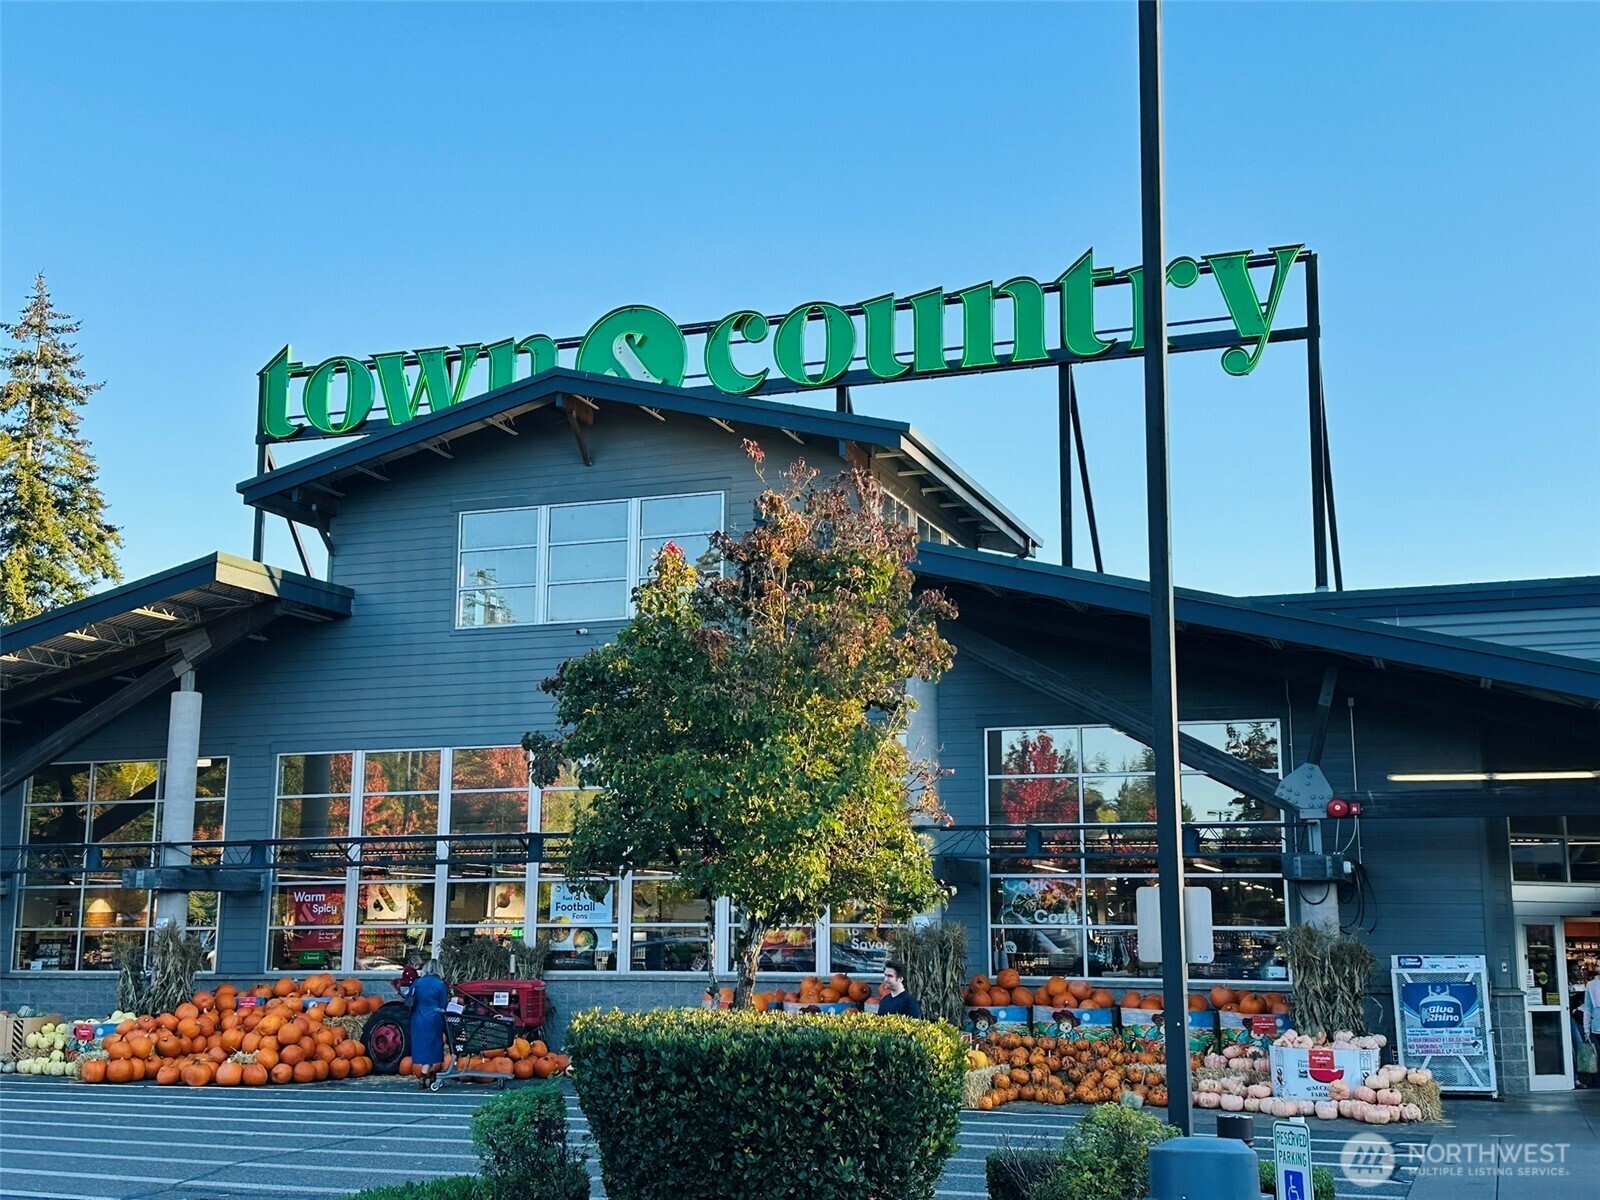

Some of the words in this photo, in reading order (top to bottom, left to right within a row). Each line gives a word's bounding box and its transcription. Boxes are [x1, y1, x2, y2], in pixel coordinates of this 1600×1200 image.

[258, 334, 559, 438] town
[703, 243, 1306, 396] country
[294, 892, 325, 902] Warm
[312, 904, 337, 914] Spicy
[555, 902, 596, 912] Football
[851, 938, 889, 950] Savor
[1428, 1005, 1454, 1013] Blue
[1427, 1013, 1460, 1022] Rhino
[1276, 1130, 1307, 1147] RESERVED
[1278, 1150, 1307, 1167] PARKING
